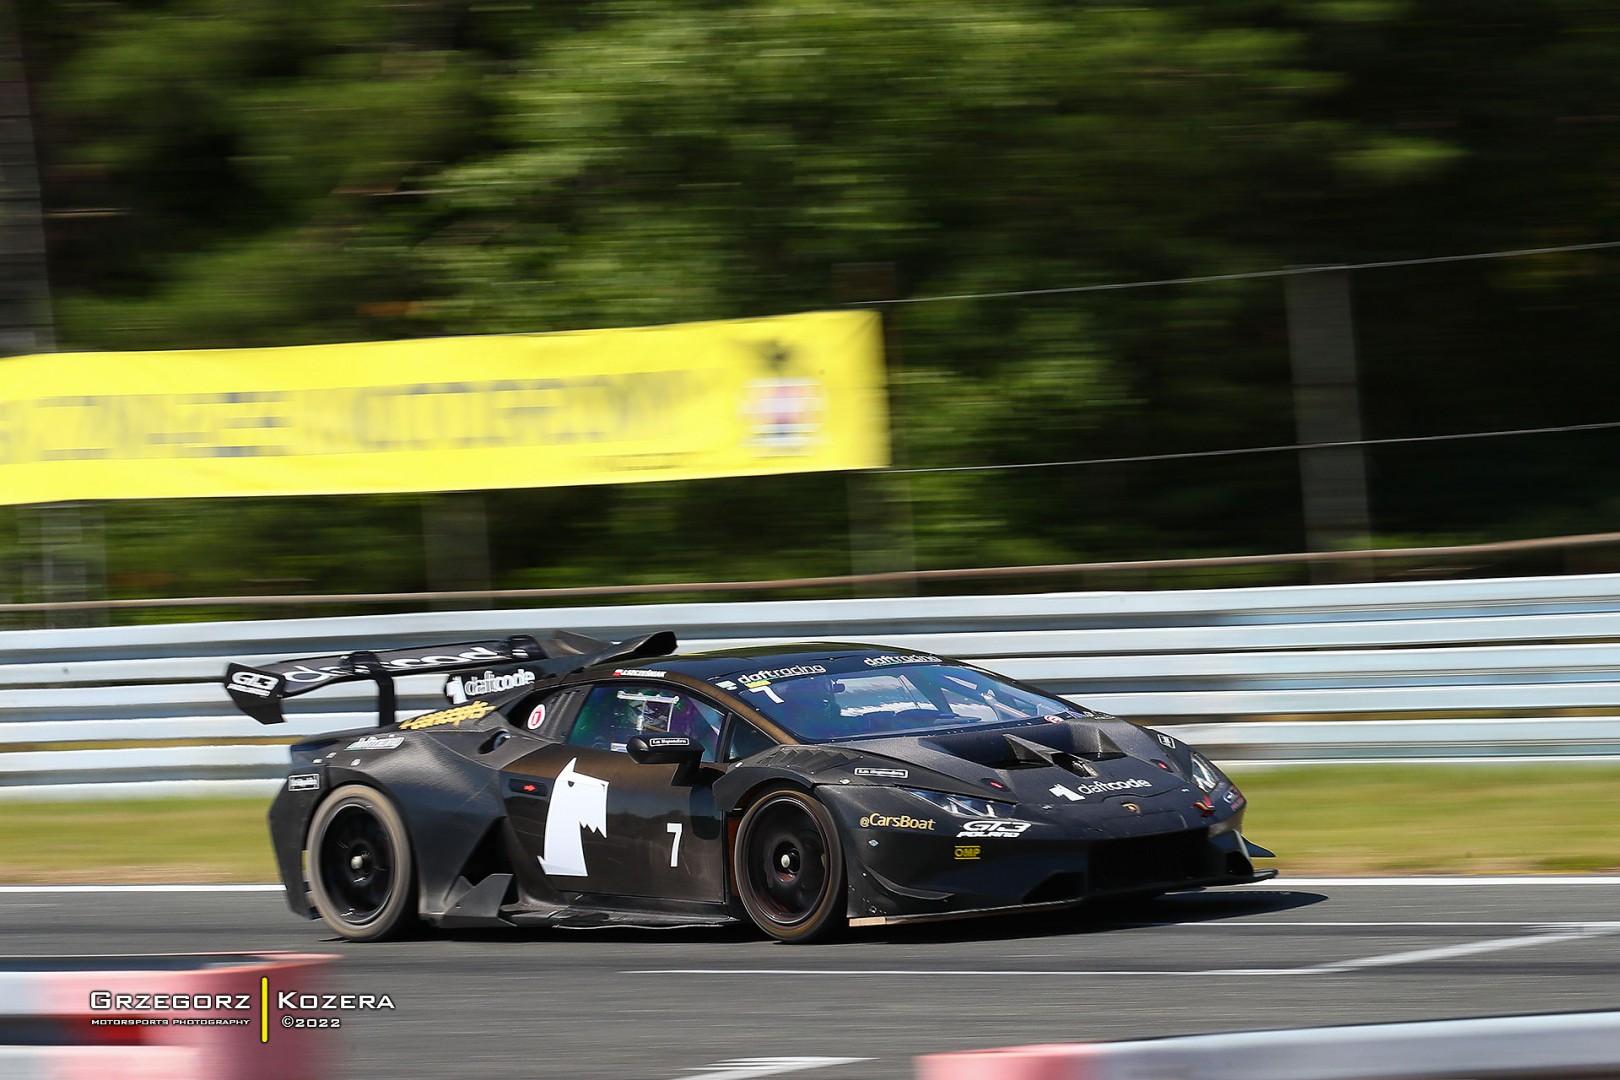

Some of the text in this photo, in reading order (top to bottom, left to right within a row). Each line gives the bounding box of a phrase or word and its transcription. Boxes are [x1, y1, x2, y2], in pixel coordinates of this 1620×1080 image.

[465, 669, 536, 696] daftcode
[737, 664, 827, 684] daftracing
[749, 685, 785, 704] 7
[1077, 779, 1152, 795] daftcode
[859, 812, 936, 831] @CarsBoat
[963, 821, 1032, 833] GT3
[666, 822, 683, 867] 7
[954, 848, 981, 857] OMP
